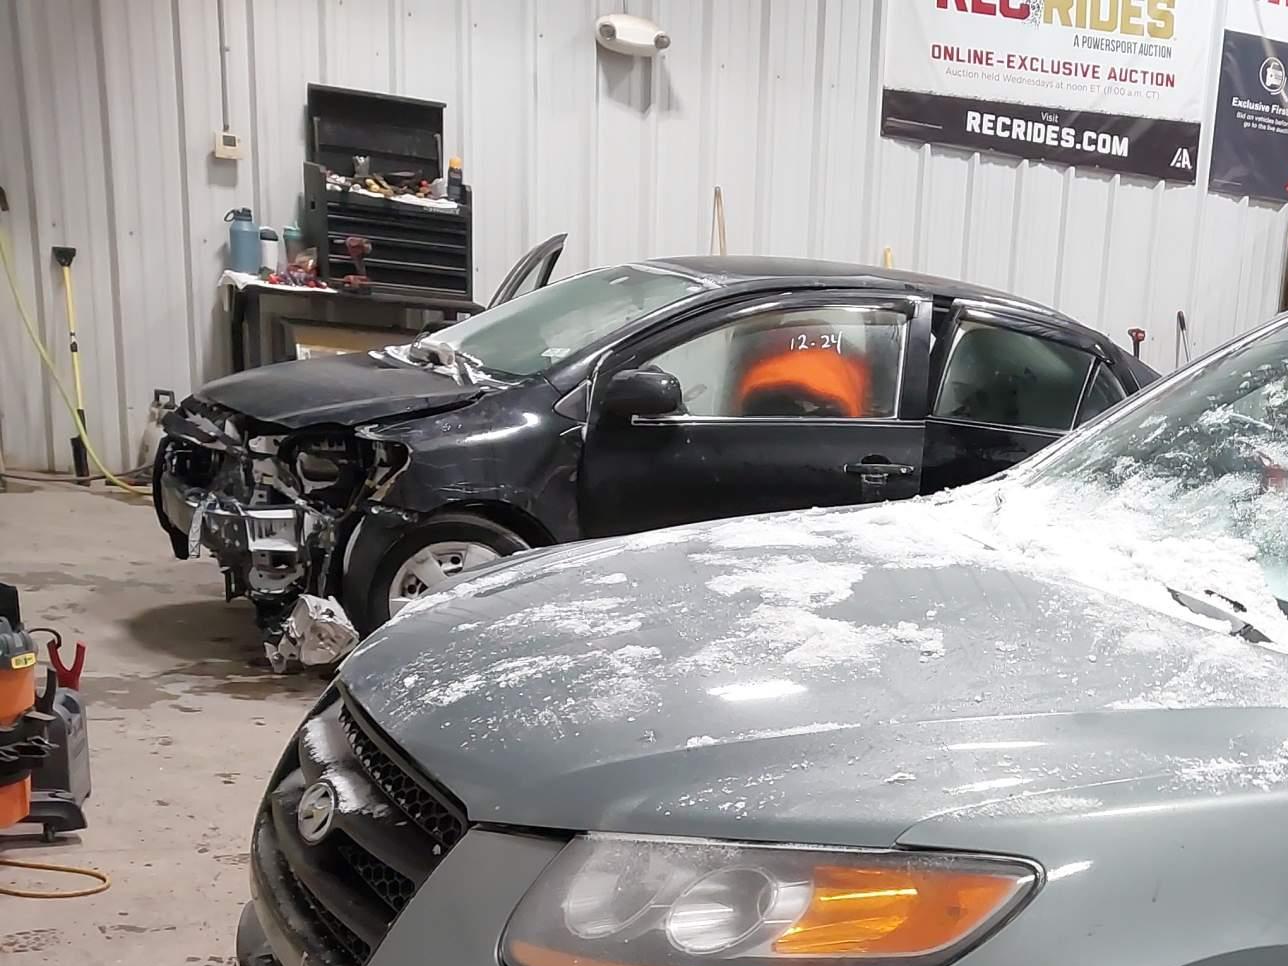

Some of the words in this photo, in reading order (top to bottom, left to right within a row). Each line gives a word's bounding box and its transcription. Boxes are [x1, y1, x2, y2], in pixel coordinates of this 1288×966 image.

[1043, 0, 1176, 40] RIDES
[1073, 34, 1080, 48] A
[1081, 35, 1137, 55] POWERSPORT
[1138, 43, 1172, 59] AUCTION
[931, 44, 1101, 80] ONLINE-EXCLUSIVE
[1107, 66, 1175, 88] AUCTION
[945, 66, 979, 79] Auction
[981, 72, 1000, 82] held
[1003, 73, 1053, 89] Wednesdays
[1066, 82, 1088, 92] noon
[1041, 111, 1059, 123] Visit
[1232, 97, 1270, 113] Exclusive
[1271, 104, 1288, 117] First
[966, 110, 1129, 158] RECRIDES.COM
